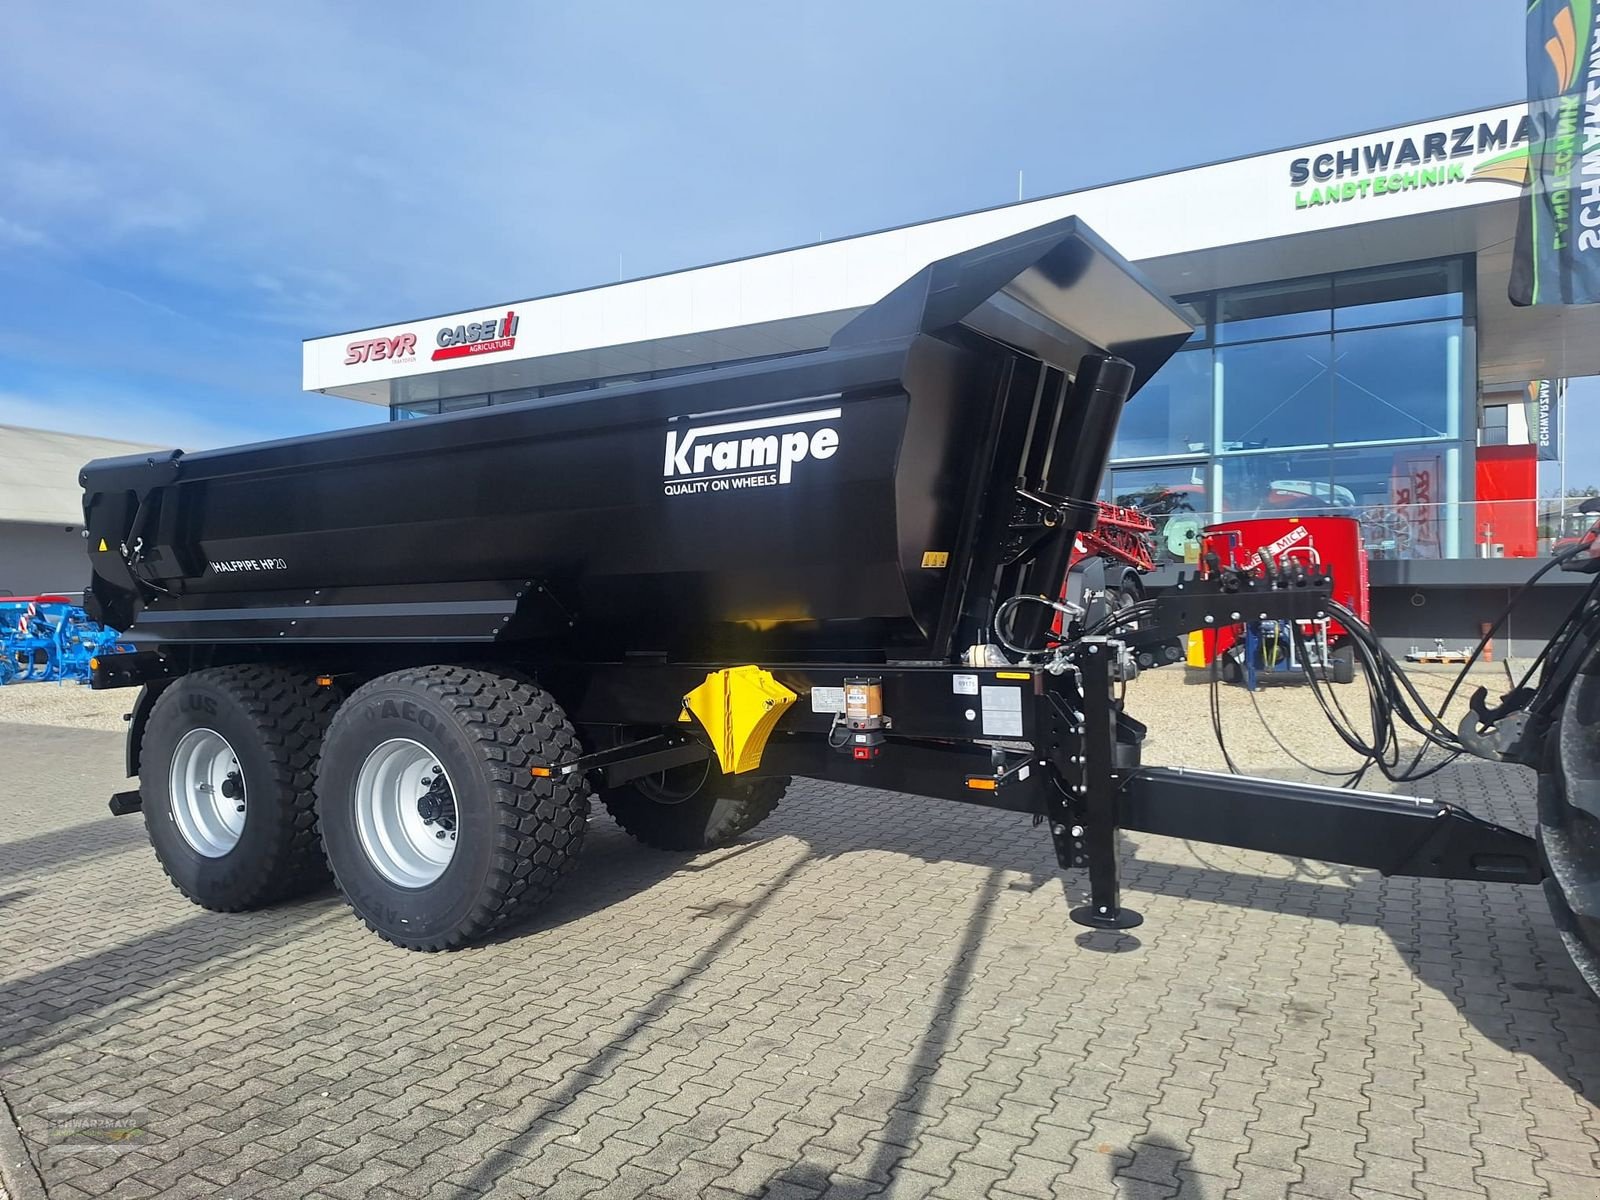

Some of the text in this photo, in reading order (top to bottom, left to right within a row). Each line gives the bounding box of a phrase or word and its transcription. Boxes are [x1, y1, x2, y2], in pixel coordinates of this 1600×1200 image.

[1290, 110, 1561, 186] SCHWARZMAY
[1295, 163, 1464, 209] LANDTECHNIK
[436, 319, 497, 347] CASE
[469, 340, 511, 353] AGRICULTURE
[344, 333, 417, 366] STEYR
[663, 407, 842, 484] Krampe
[664, 474, 777, 496] QUALITY ON WHEELS
[1276, 527, 1307, 550] MICH
[212, 558, 287, 573] HALFPIPE HP20
